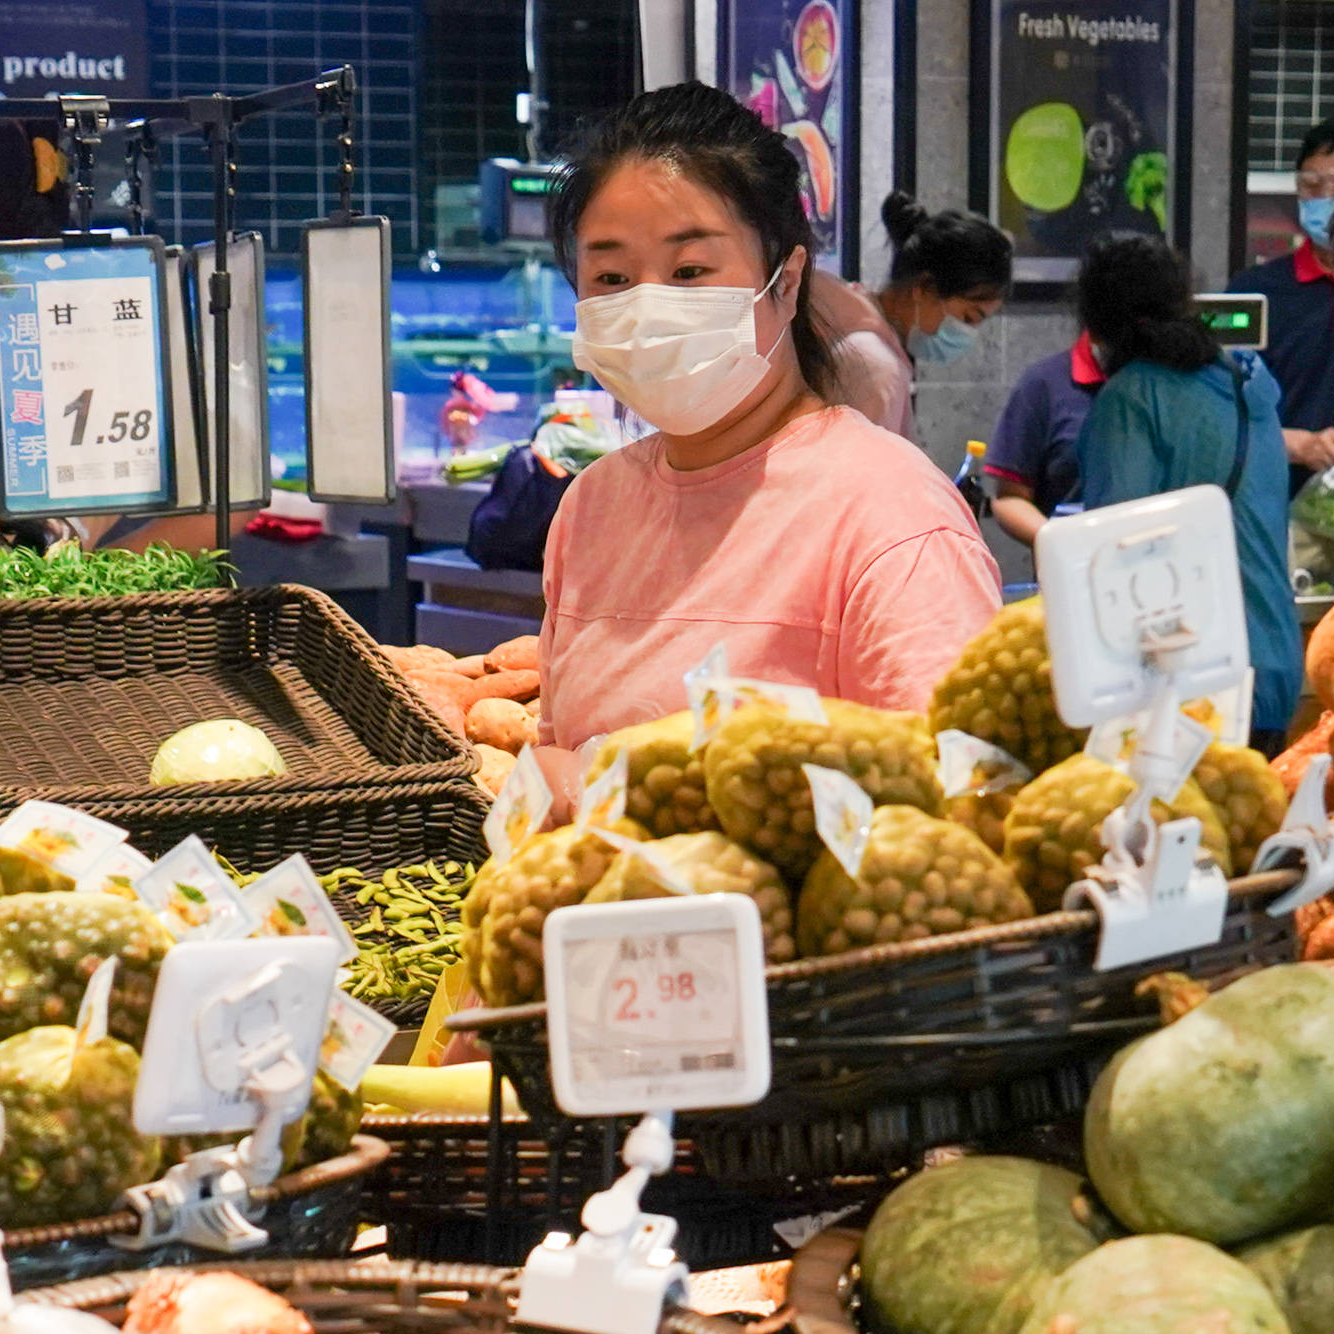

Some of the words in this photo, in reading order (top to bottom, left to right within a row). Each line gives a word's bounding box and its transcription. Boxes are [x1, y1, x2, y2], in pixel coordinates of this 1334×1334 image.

[1018, 12, 1064, 38] Fresh
[1067, 14, 1160, 46] Vegetables
[3, 51, 126, 84] product
[47, 298, 143, 326] 甘蓝
[63, 388, 152, 447] 1.58
[7, 428, 20, 488] SUMMER
[612, 971, 697, 1022] 2.98
